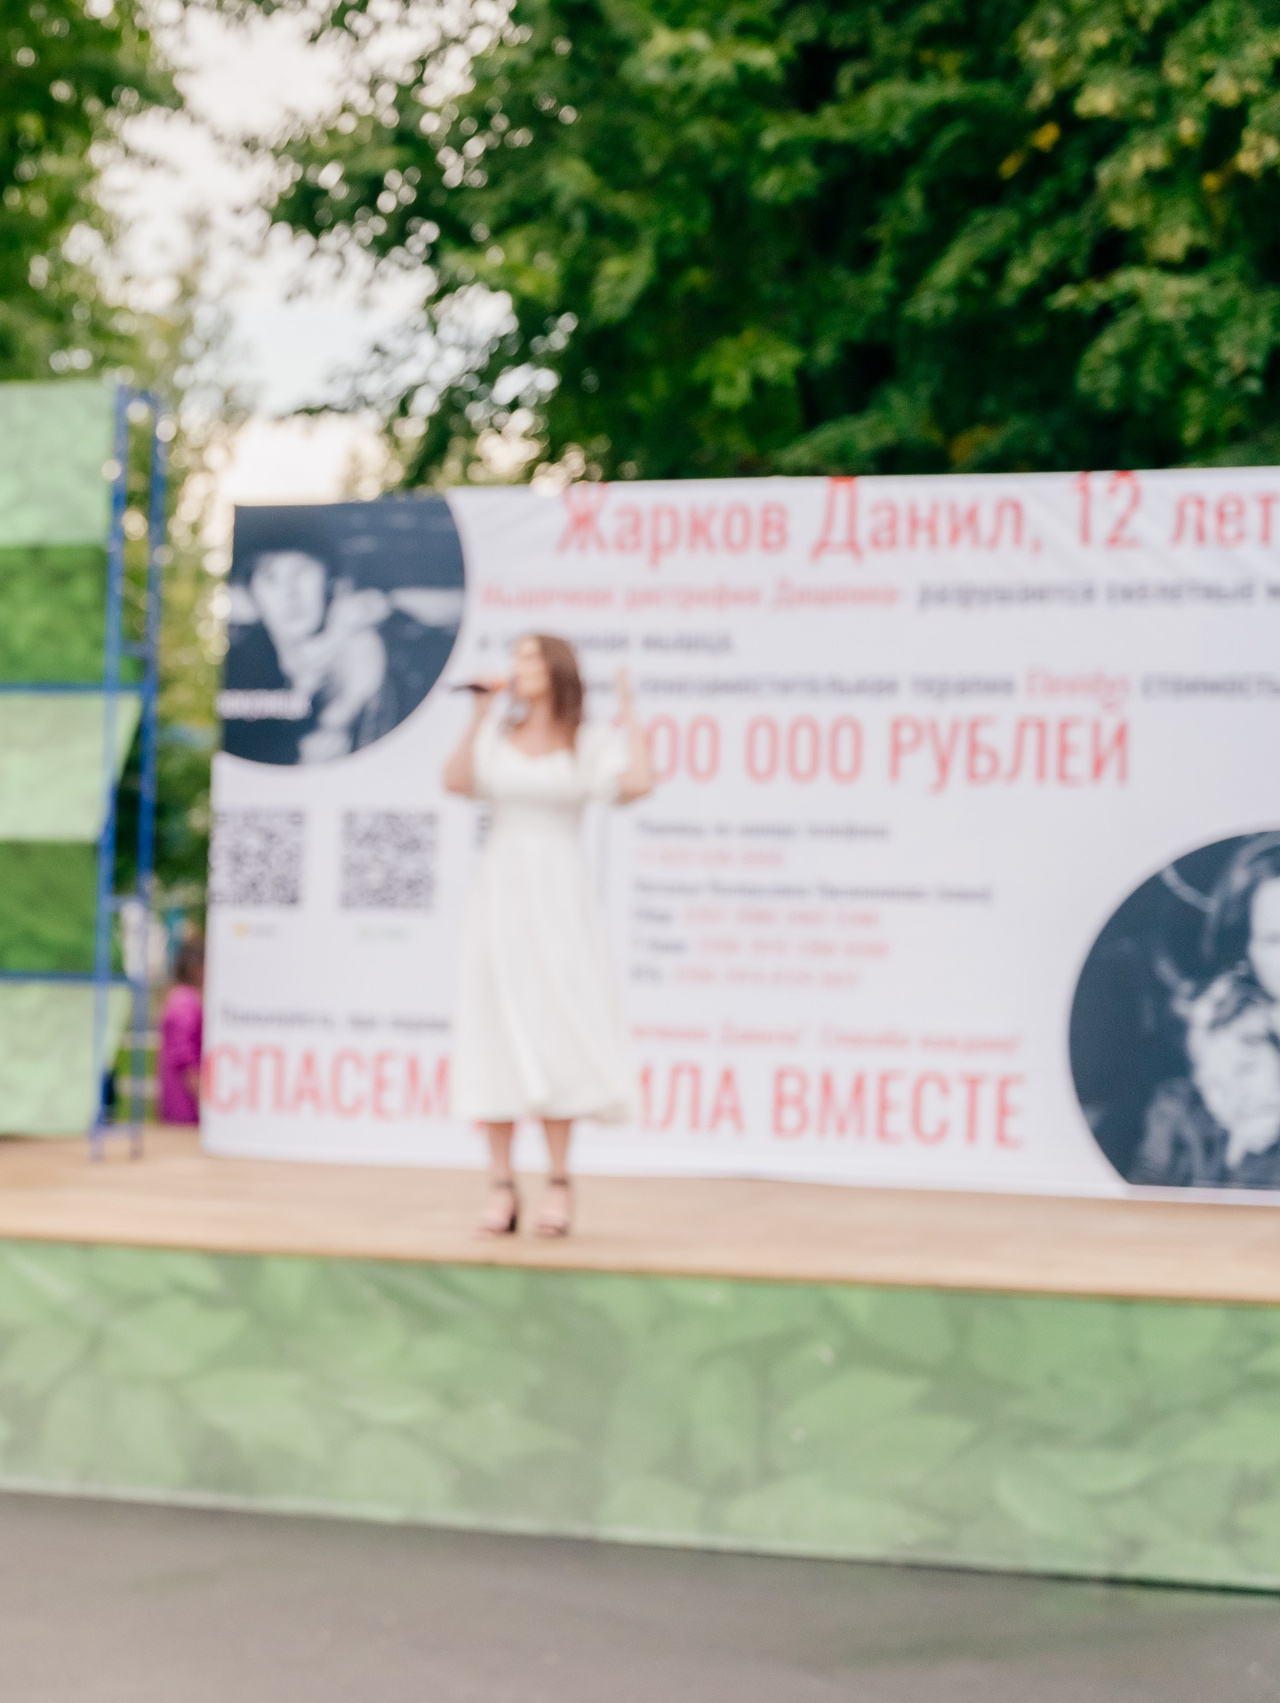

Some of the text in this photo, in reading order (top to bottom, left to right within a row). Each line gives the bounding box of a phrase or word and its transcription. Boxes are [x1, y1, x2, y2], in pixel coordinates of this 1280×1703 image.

[555, 470, 1280, 569] Жарков Данил, 12 лет
[613, 702, 1128, 796] 00 000 РУБЛЕЙ
[203, 1043, 448, 1120] СПАСЕМ
[772, 1064, 1025, 1150] ВМЕСТЕ
